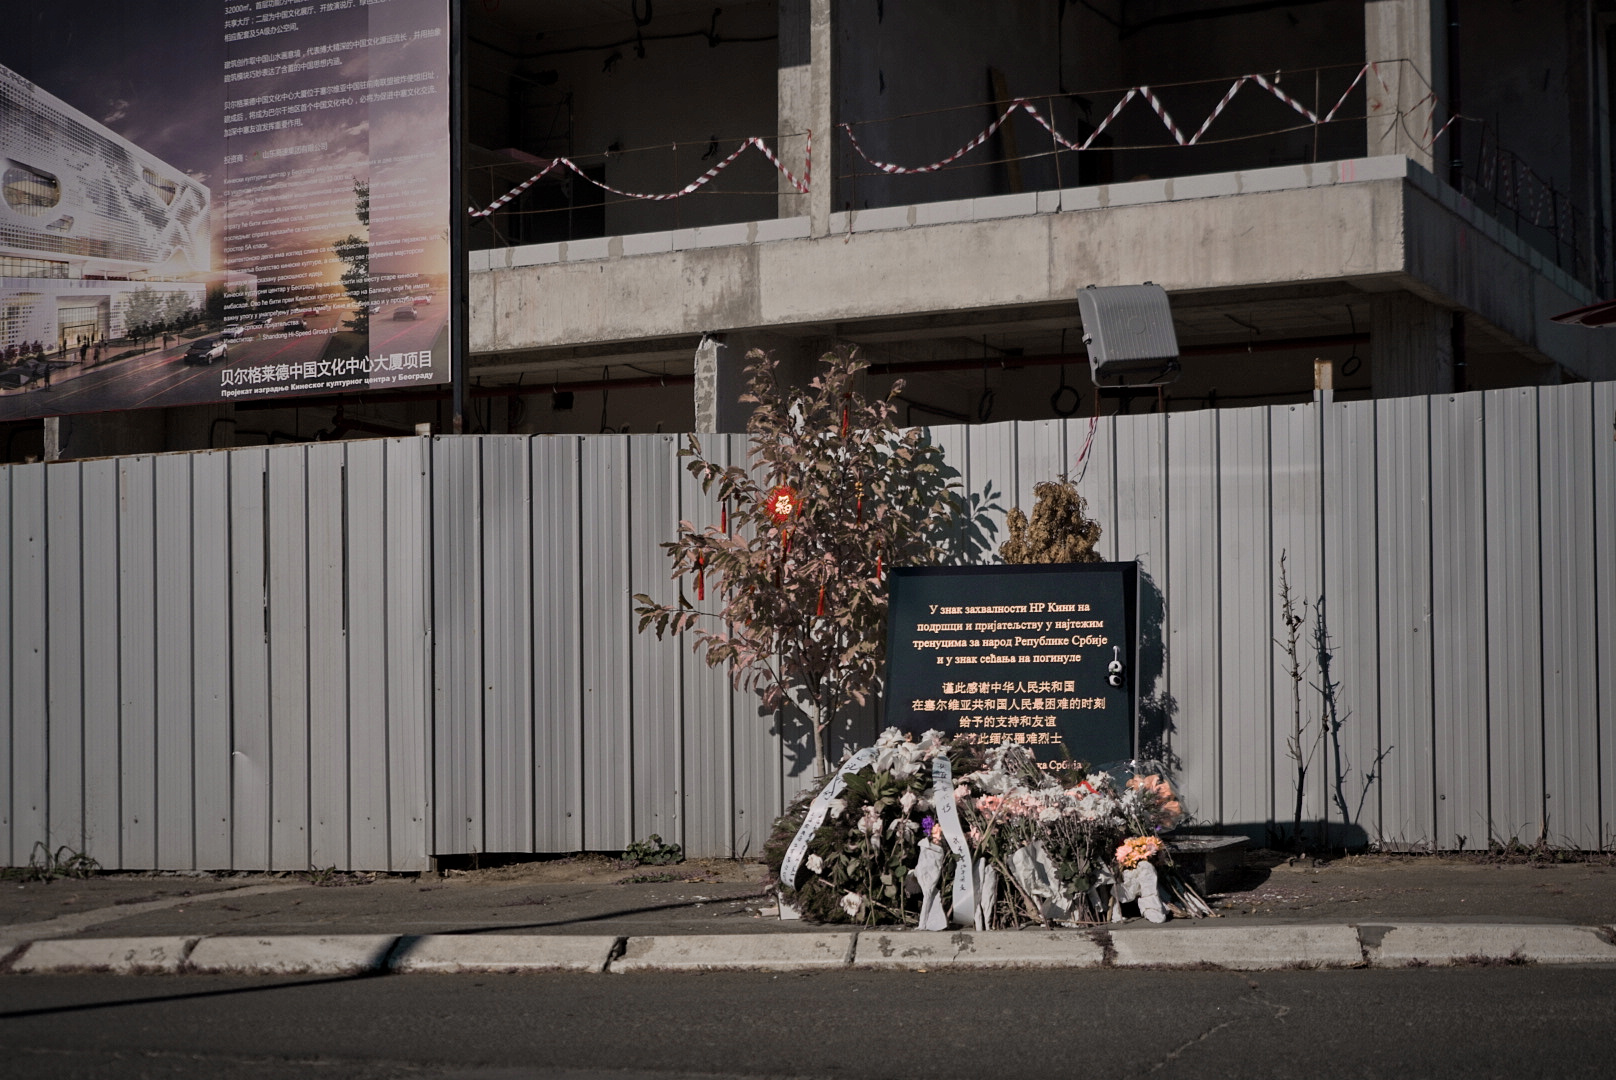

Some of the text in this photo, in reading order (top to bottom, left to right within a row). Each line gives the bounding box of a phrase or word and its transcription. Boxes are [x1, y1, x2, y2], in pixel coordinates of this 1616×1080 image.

[221, 350, 432, 386] 贝尔格莱德中国文化中心大厦项目
[222, 388, 252, 397] Пројекат
[254, 384, 289, 394] изградње
[291, 381, 324, 390] Кинеског
[326, 378, 363, 389] културног
[364, 376, 390, 385] центра
[398, 371, 434, 381] Београду
[929, 603, 1090, 615] У знак захвалности НР Кини на
[917, 622, 963, 633] подршци
[975, 620, 1043, 632] пријатељству
[1046, 622, 1052, 631] у
[1055, 620, 1104, 632] најтежим
[912, 636, 1108, 650] тренуцима за народ Републике Србије
[936, 653, 1081, 666] и у знак сећања на погинуле
[942, 681, 1075, 695] 谨此感谢中华人民共和国
[912, 697, 1106, 712] 在塞尔维亚共和国人民最困难的时刻
[959, 715, 1057, 728] 给予的支持和友谊
[1049, 760, 1082, 771] Србја
